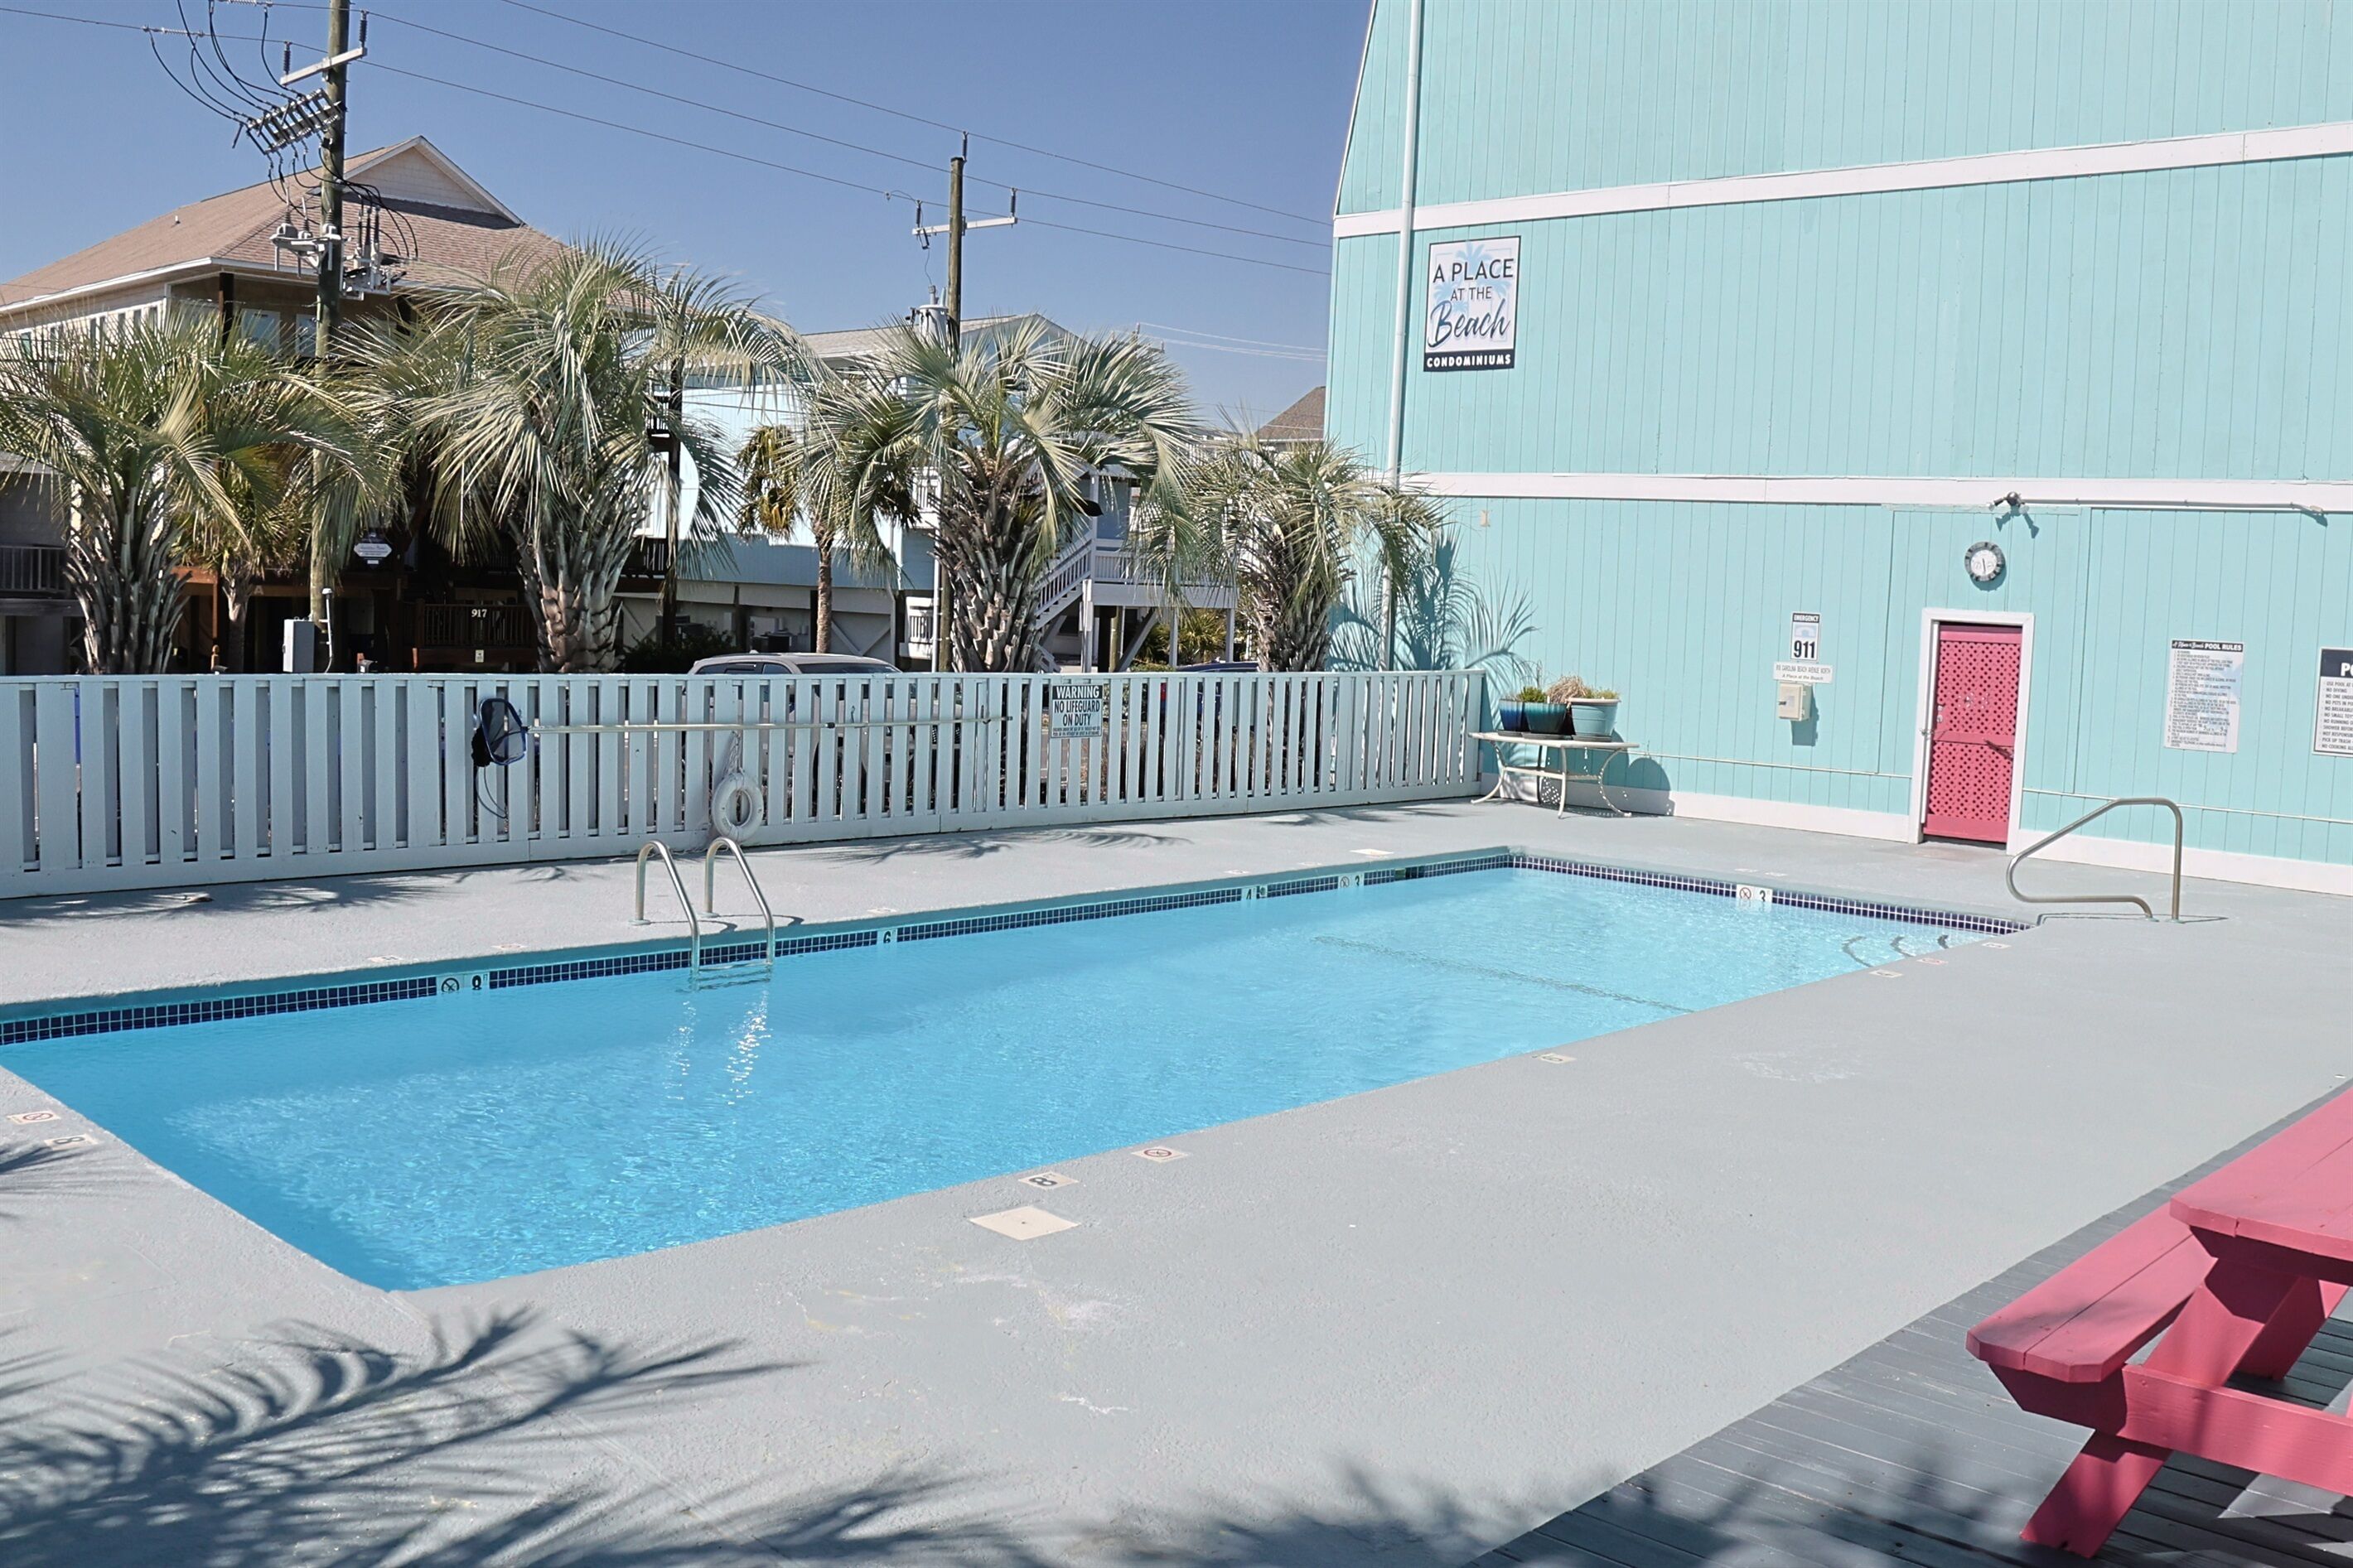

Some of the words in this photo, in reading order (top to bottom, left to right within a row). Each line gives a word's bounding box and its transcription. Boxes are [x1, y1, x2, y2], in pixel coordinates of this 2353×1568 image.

[1433, 263, 1445, 283] A
[1452, 258, 1515, 282] PLACE
[1451, 287, 1466, 302] AT
[1468, 287, 1492, 301] THE
[1427, 298, 1511, 348] Beach
[1426, 354, 1511, 368] CONDOMINIUMS
[471, 609, 487, 618] 917
[1794, 614, 1819, 622] EMERGENCY
[1794, 639, 1815, 659] 911
[2341, 663, 2353, 677] P
[1056, 686, 1099, 699] WARNING
[1054, 701, 1065, 713] NO
[1066, 700, 1100, 713] LIFEGUARD
[1063, 714, 1073, 726] ON
[1075, 713, 1091, 726] DUTY
[1028, 1176, 1058, 1187] 8
